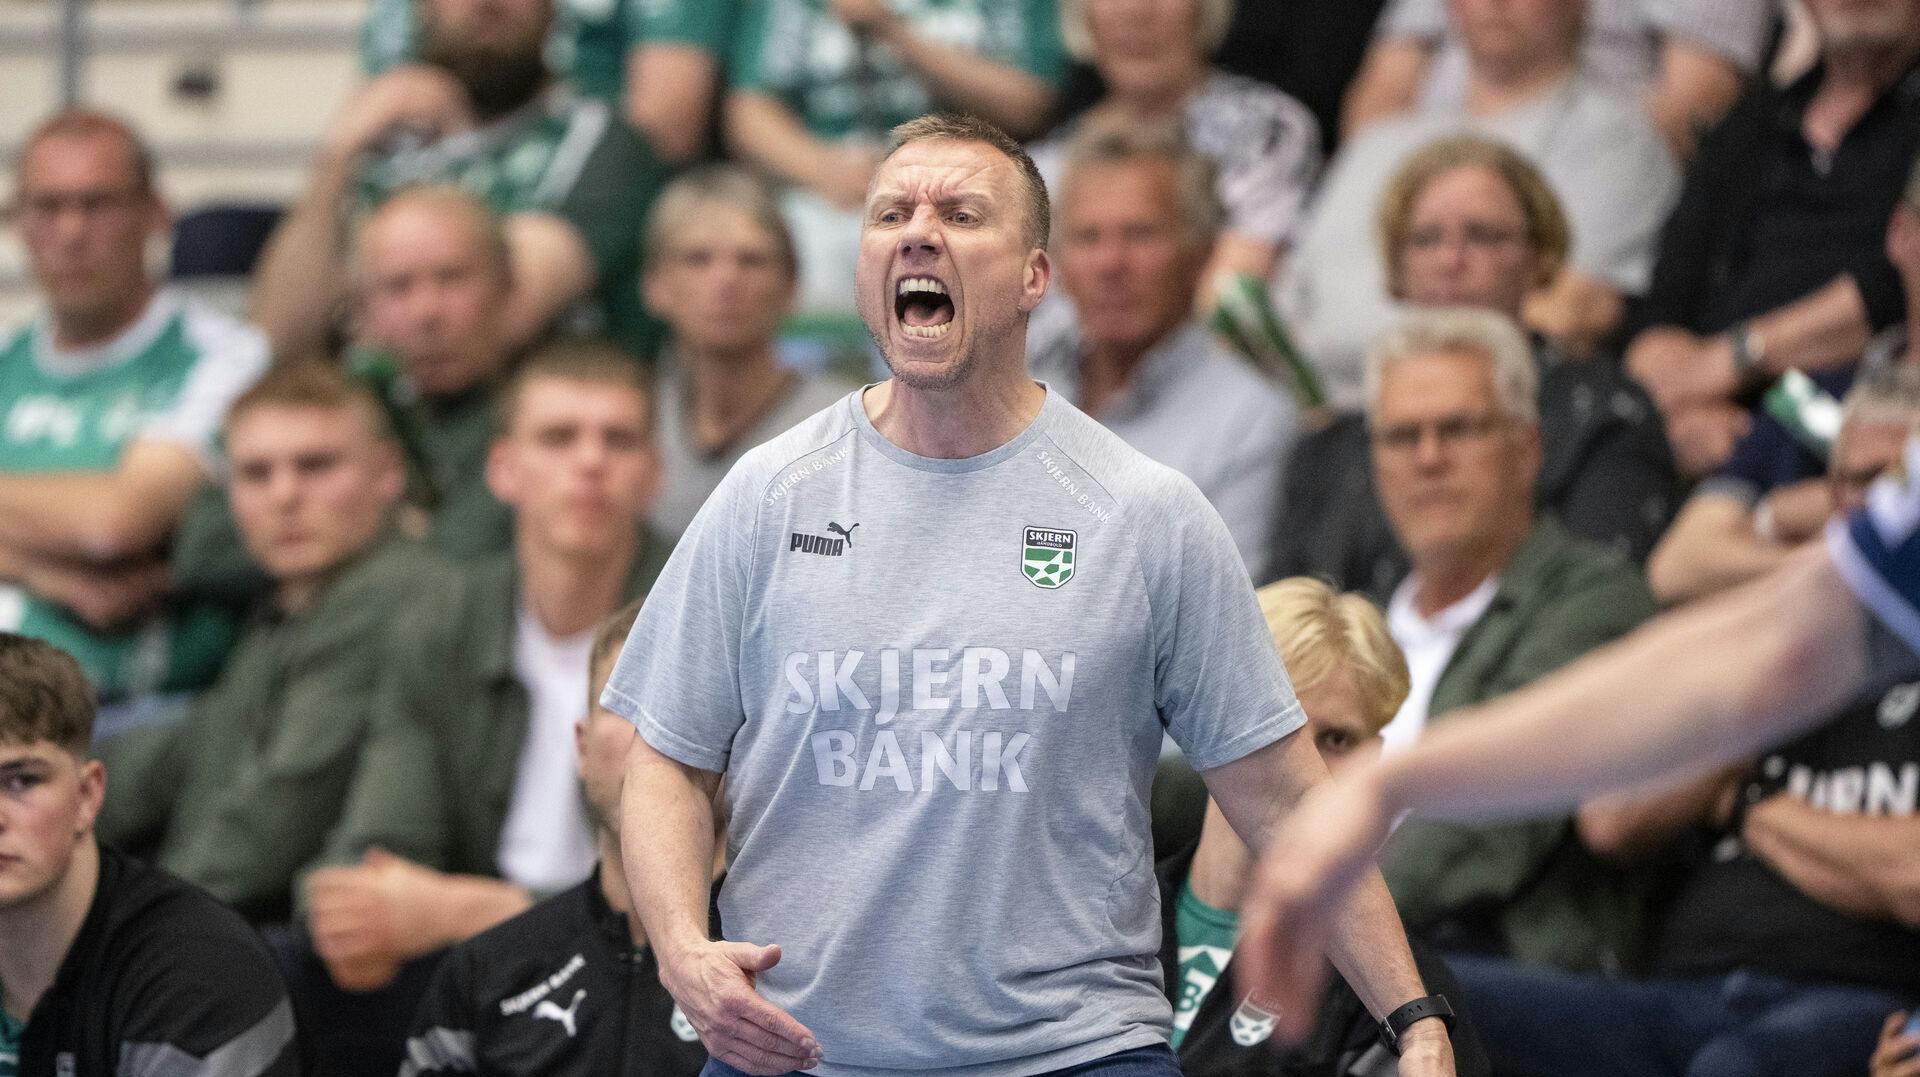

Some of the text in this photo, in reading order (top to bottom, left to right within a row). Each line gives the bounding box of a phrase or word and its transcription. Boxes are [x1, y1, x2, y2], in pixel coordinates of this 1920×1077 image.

[766, 446, 848, 506] SKJERN BANK
[1036, 451, 1112, 523] SKJERN BANK
[790, 533, 844, 556] PUMA
[1029, 531, 1071, 543] SKJERN
[784, 646, 1076, 725] SKJERN
[810, 729, 1031, 793] BANK
